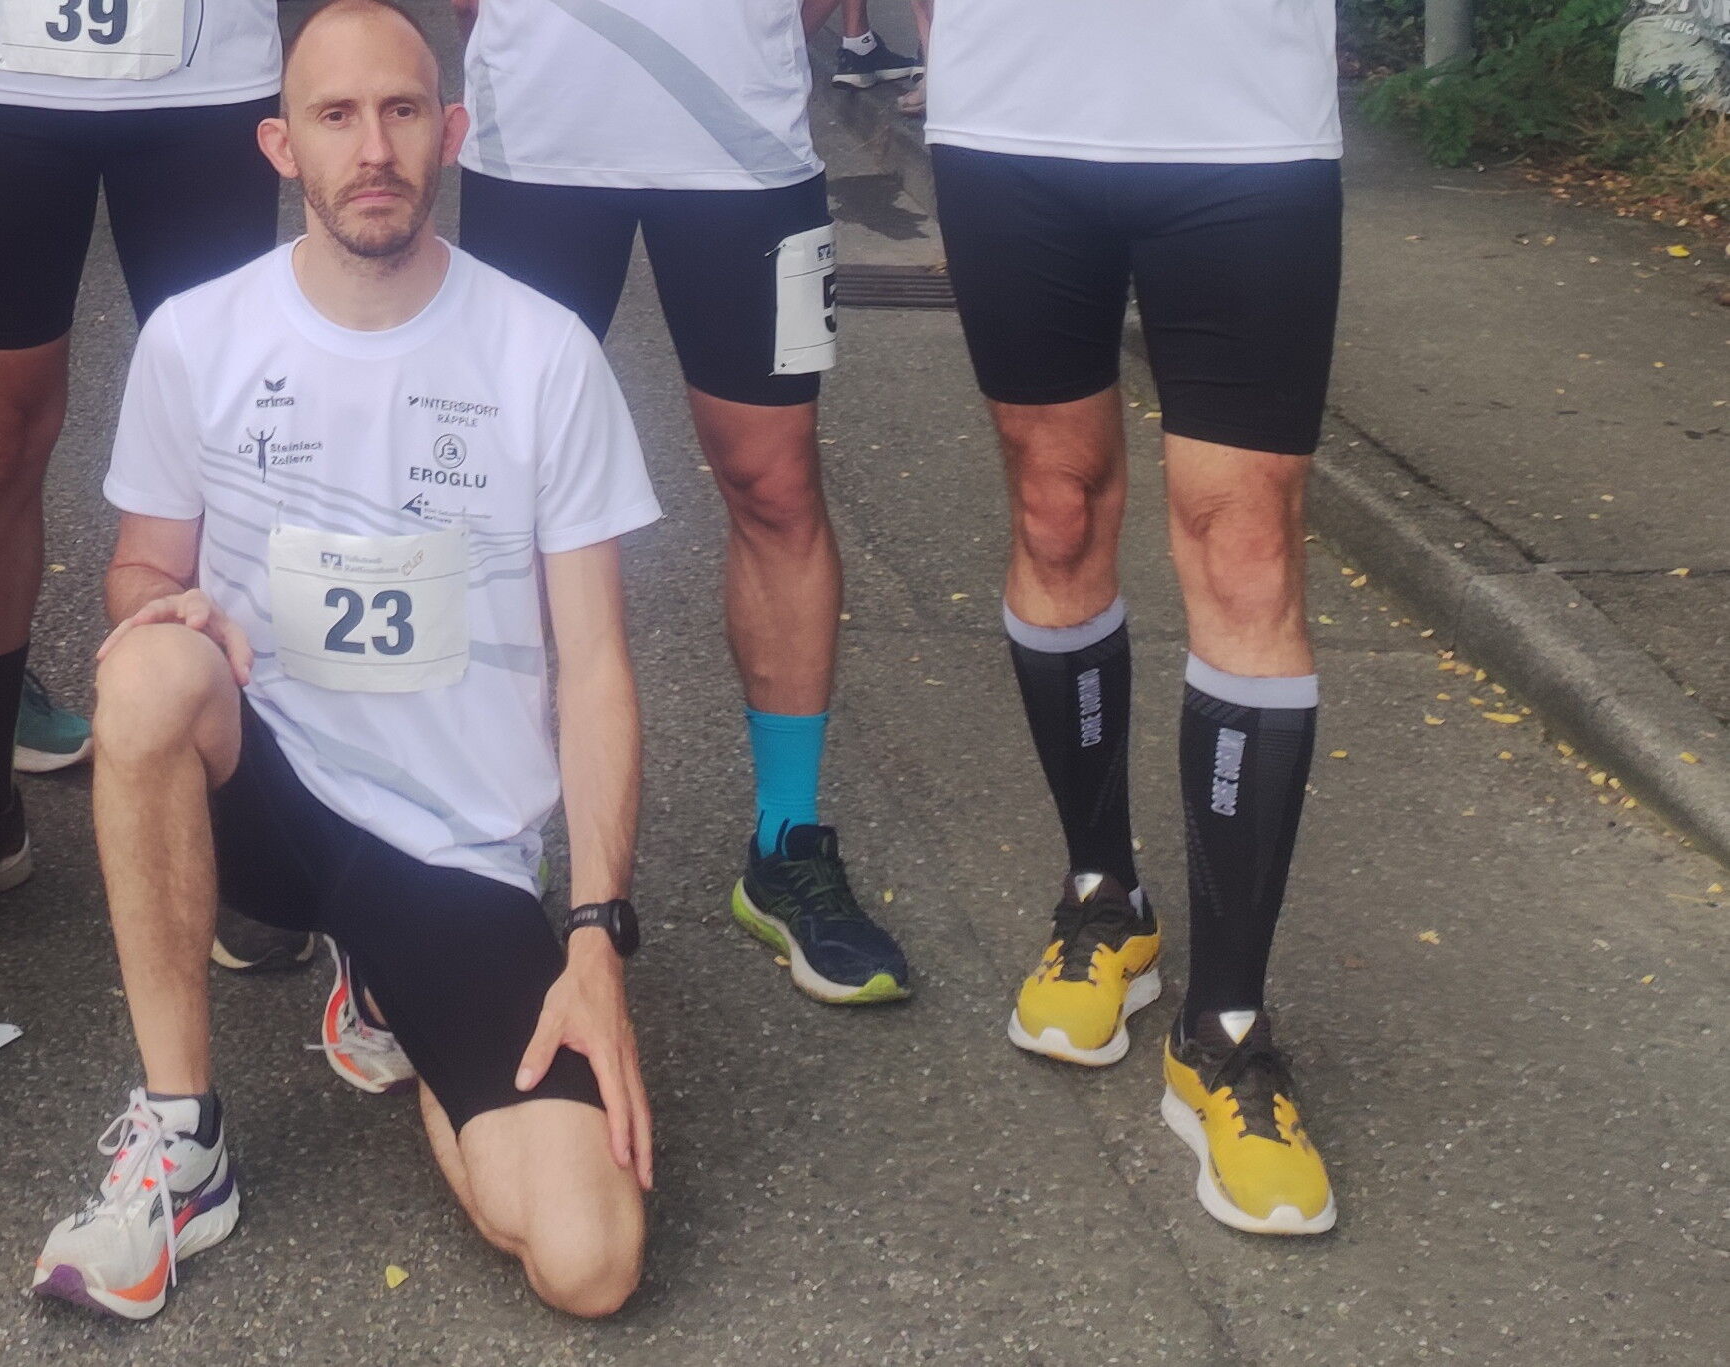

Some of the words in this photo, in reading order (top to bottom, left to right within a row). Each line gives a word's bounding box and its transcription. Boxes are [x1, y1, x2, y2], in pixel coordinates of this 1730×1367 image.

[256, 396, 295, 408] erima
[421, 397, 499, 417] INTERSPORT
[238, 444, 253, 454] LG
[271, 454, 313, 465] Zollern
[410, 466, 487, 489] EROGLU
[324, 587, 415, 656] 23
